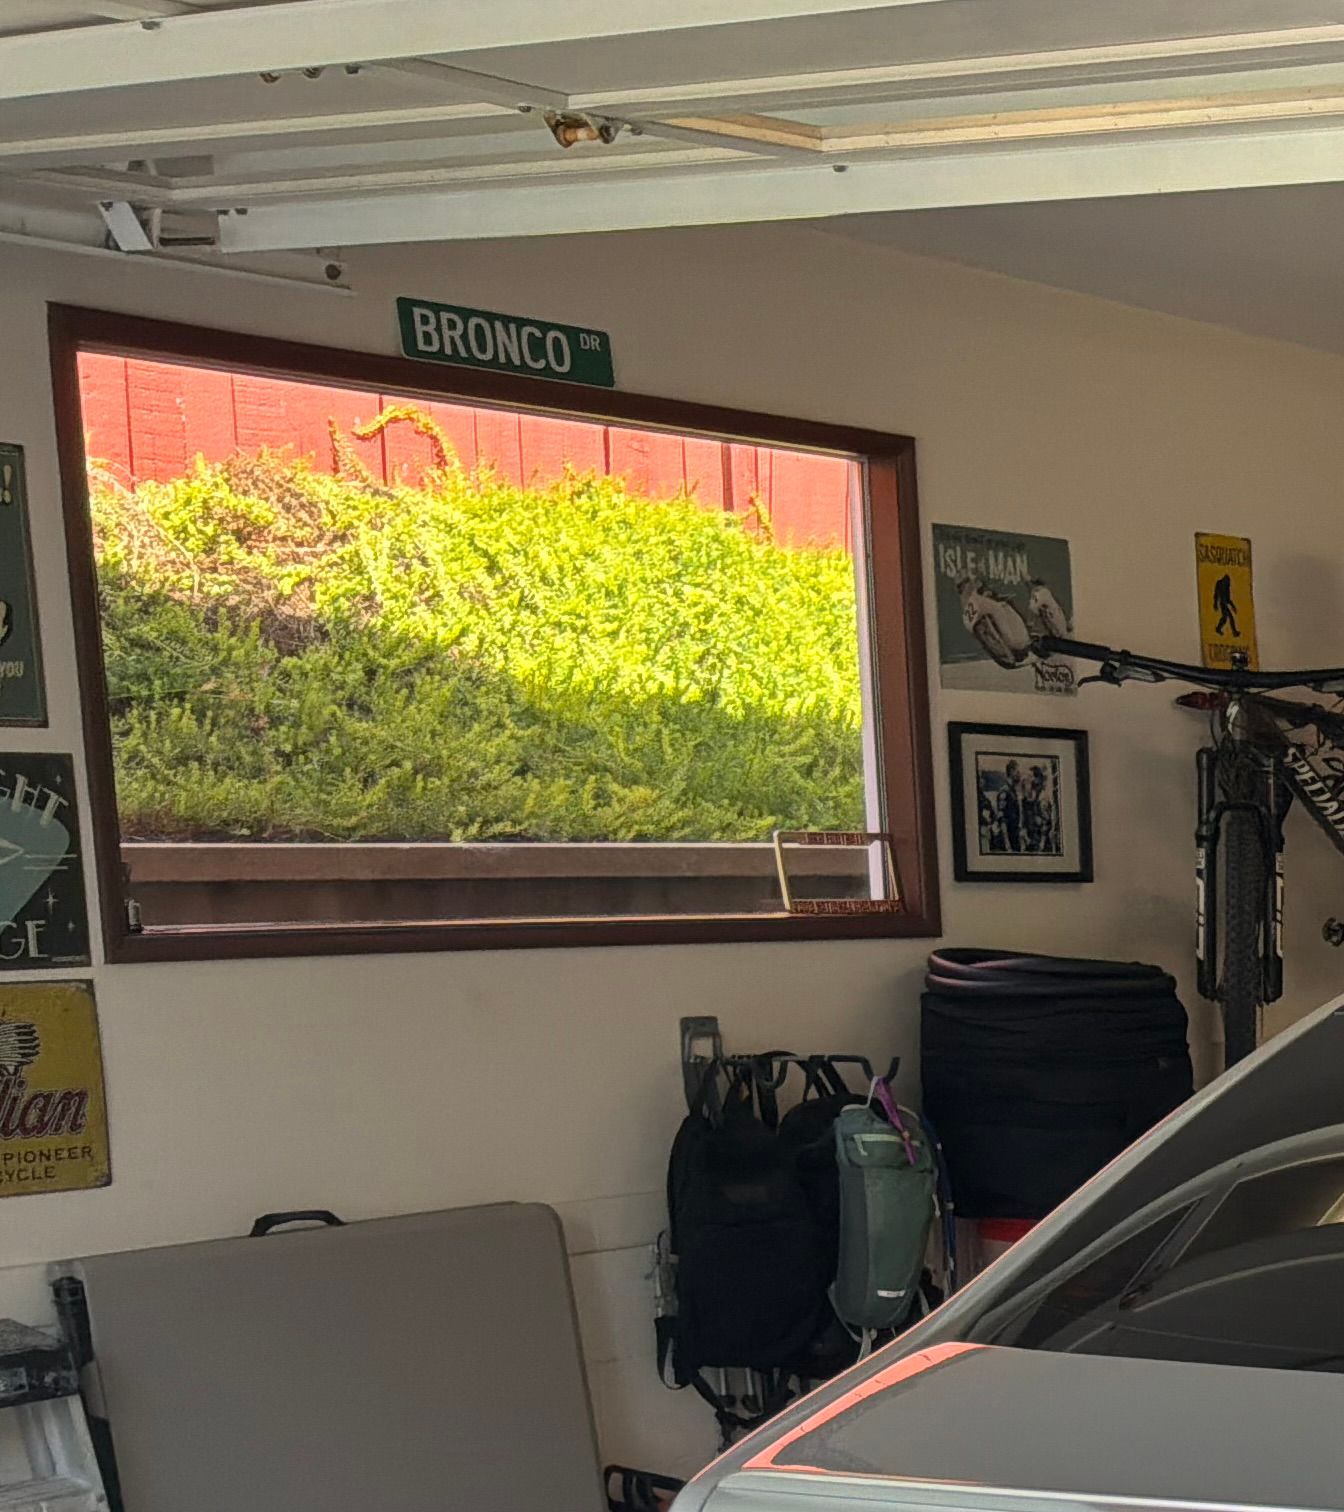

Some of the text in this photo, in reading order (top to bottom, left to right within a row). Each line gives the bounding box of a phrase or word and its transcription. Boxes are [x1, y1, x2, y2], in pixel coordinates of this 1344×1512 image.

[411, 306, 601, 374] BRONCO DR
[938, 543, 977, 578] ISLE
[987, 549, 1032, 585] MAN
[3, 1145, 93, 1166] PIONEER
